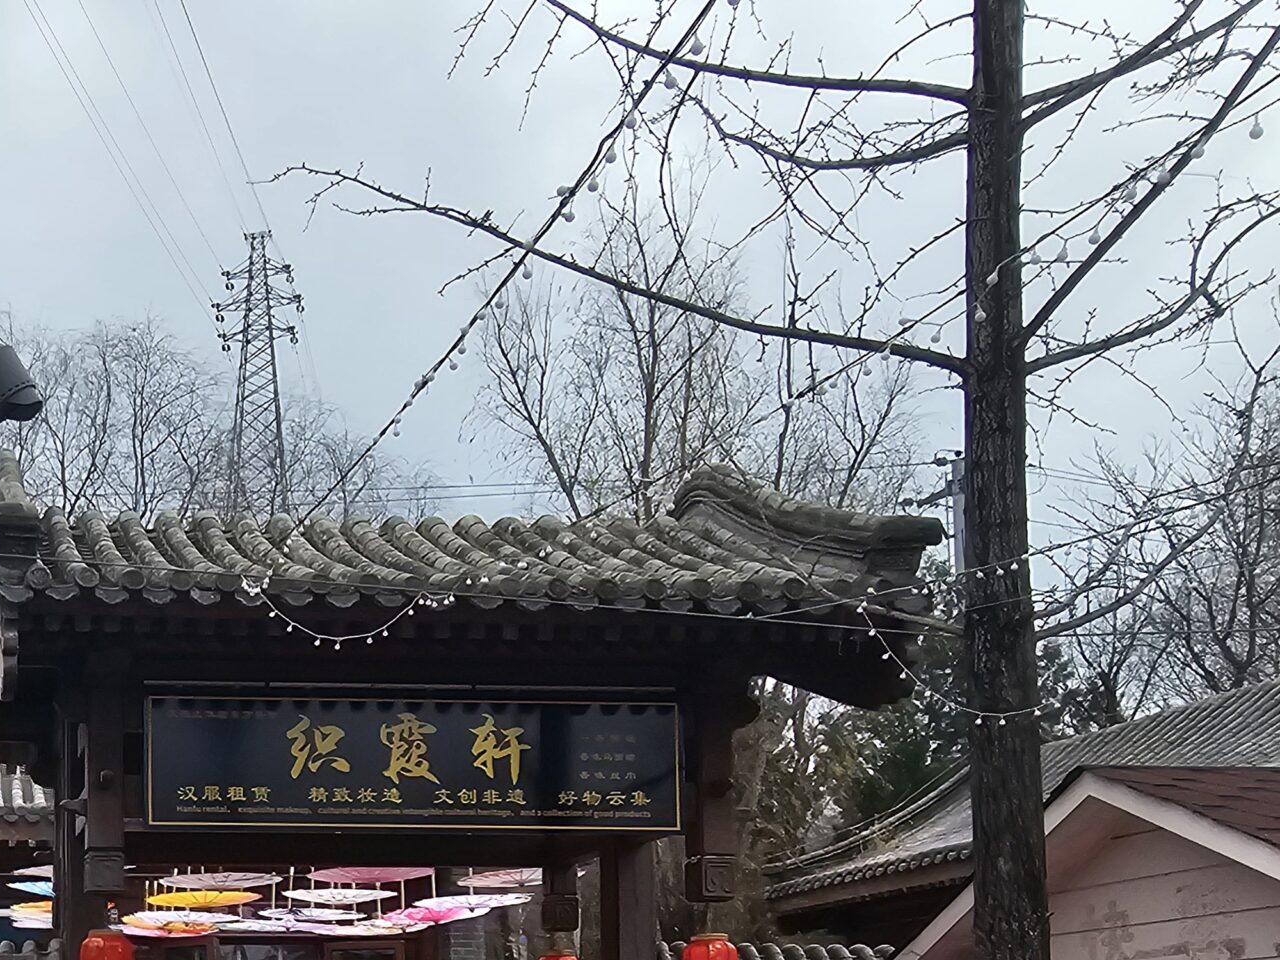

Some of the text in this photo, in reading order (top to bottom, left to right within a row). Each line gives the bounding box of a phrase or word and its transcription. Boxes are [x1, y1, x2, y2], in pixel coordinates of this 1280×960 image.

[286, 712, 532, 786] 织霞轩
[176, 785, 272, 803] 汉服租赁
[308, 786, 403, 804] 精致妆造
[433, 788, 528, 805] 文创非遗
[558, 790, 652, 806] 好物云集
